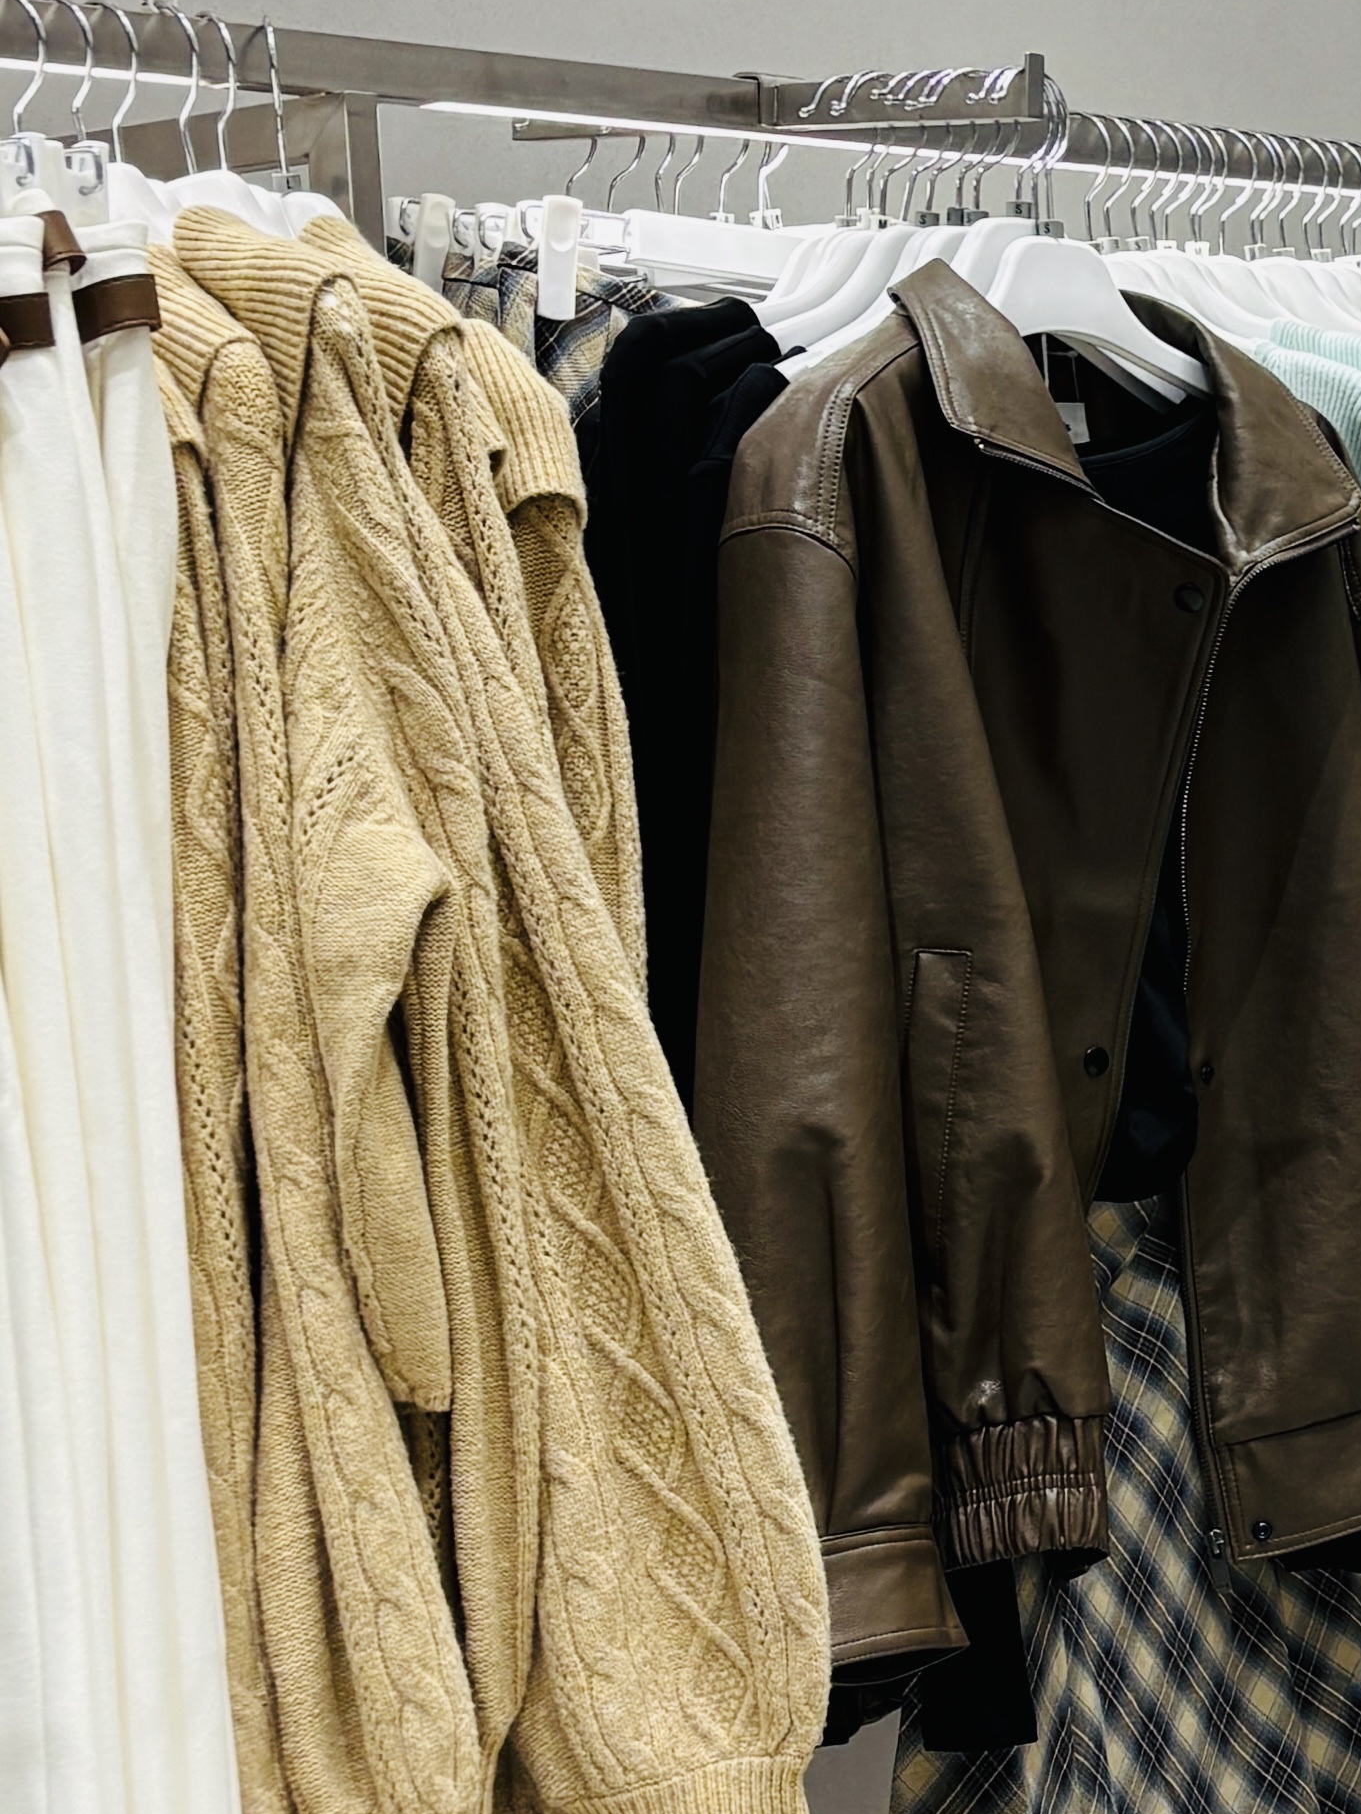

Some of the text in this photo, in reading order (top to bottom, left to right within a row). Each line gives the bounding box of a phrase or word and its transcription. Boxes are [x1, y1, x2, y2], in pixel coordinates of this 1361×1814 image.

[1015, 203, 1023, 215] S
[918, 214, 927, 225] S
[1043, 223, 1051, 234] S
